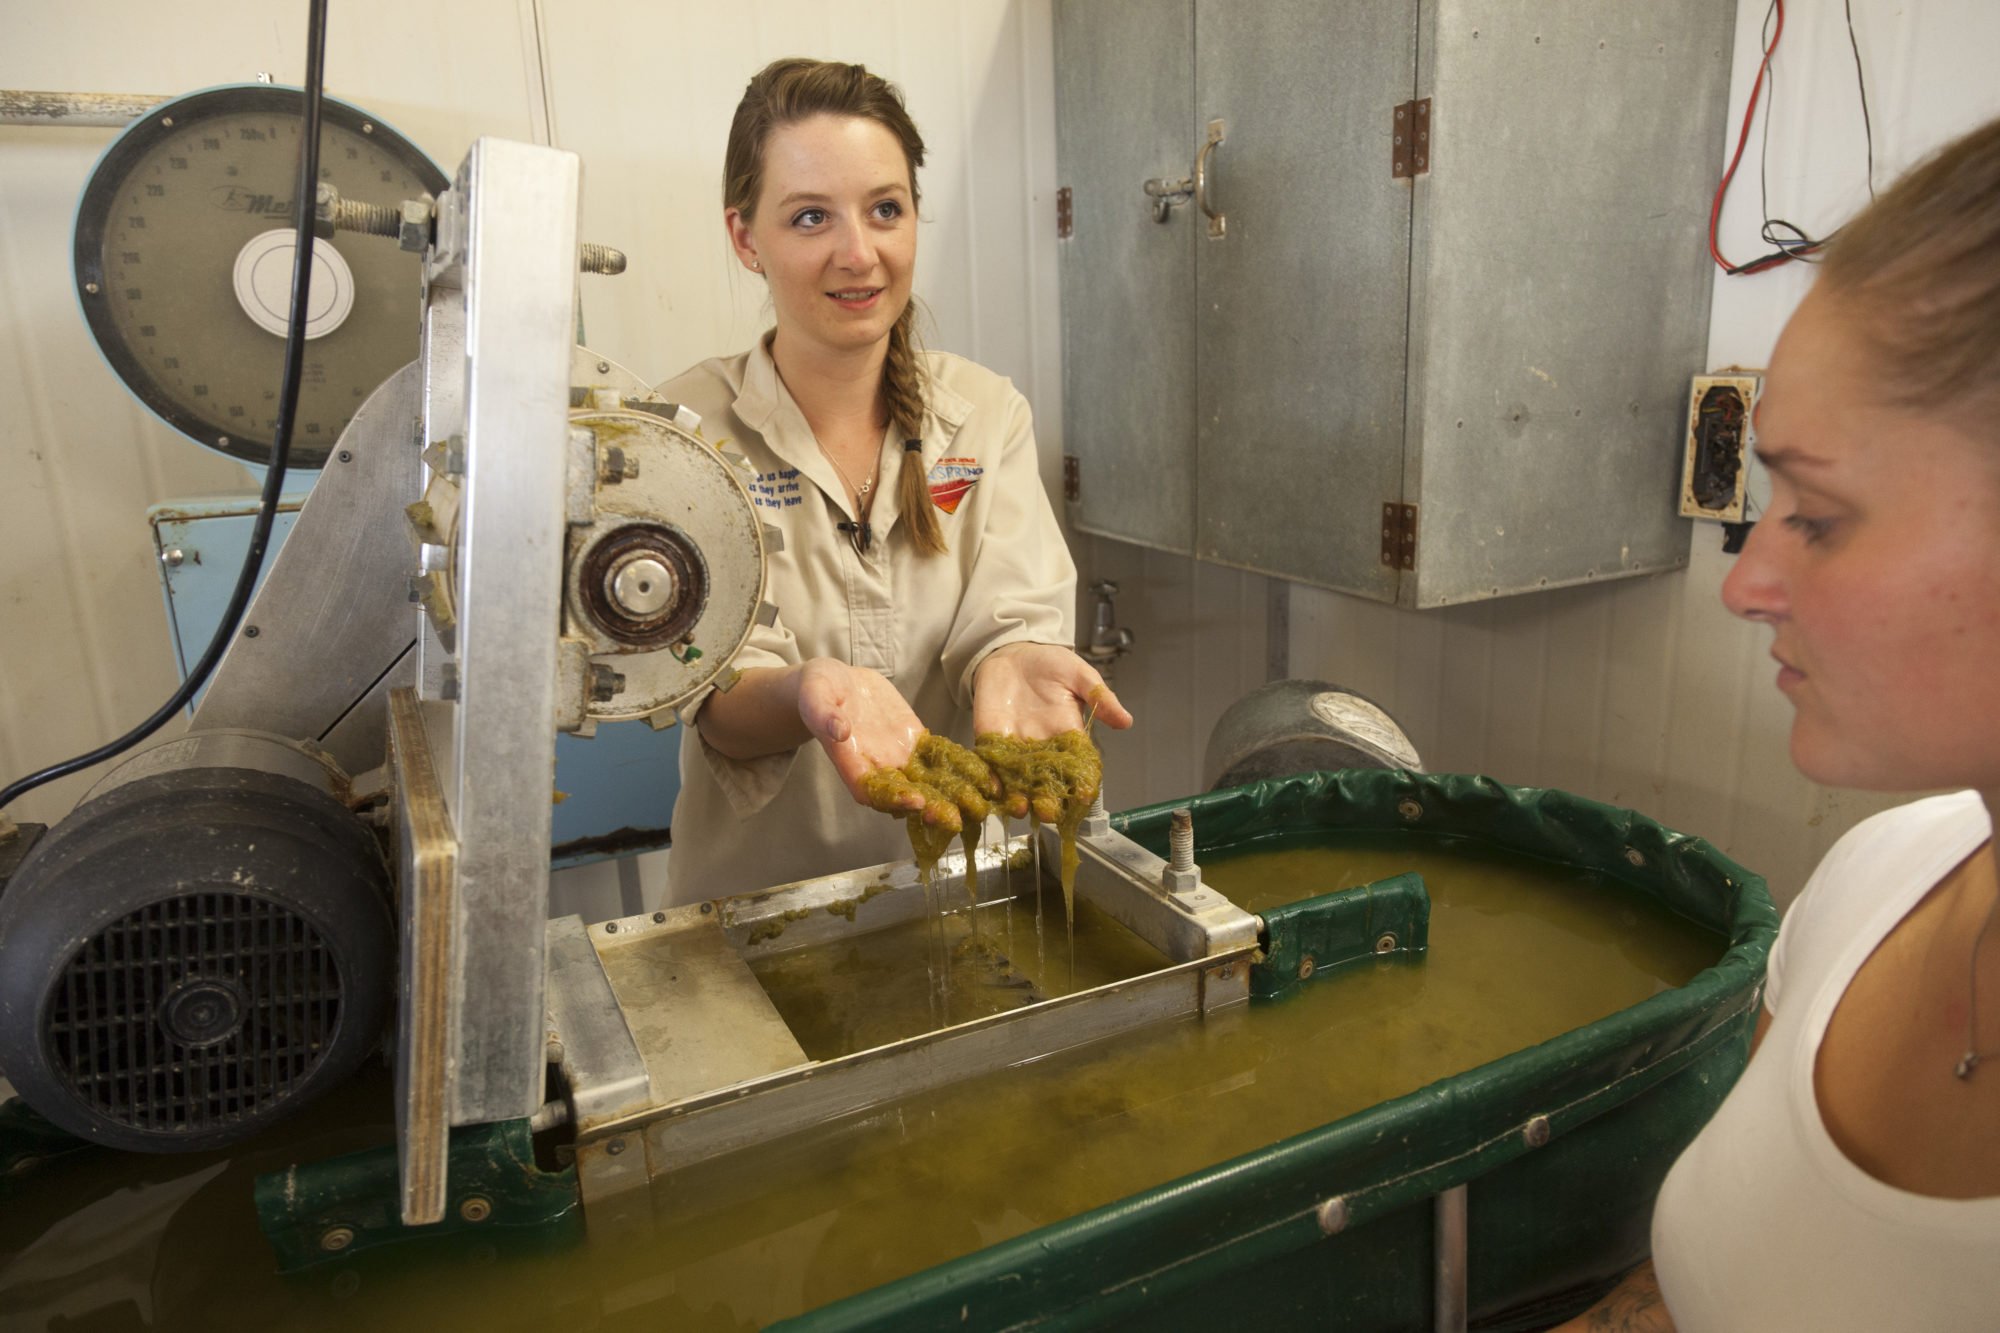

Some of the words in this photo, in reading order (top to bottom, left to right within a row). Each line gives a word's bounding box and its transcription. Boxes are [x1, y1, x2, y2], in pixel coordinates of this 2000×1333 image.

[779, 469, 798, 481] happ
[758, 484, 774, 497] they
[777, 481, 799, 493] arrive
[764, 497, 780, 509] they
[783, 495, 802, 507] leave
